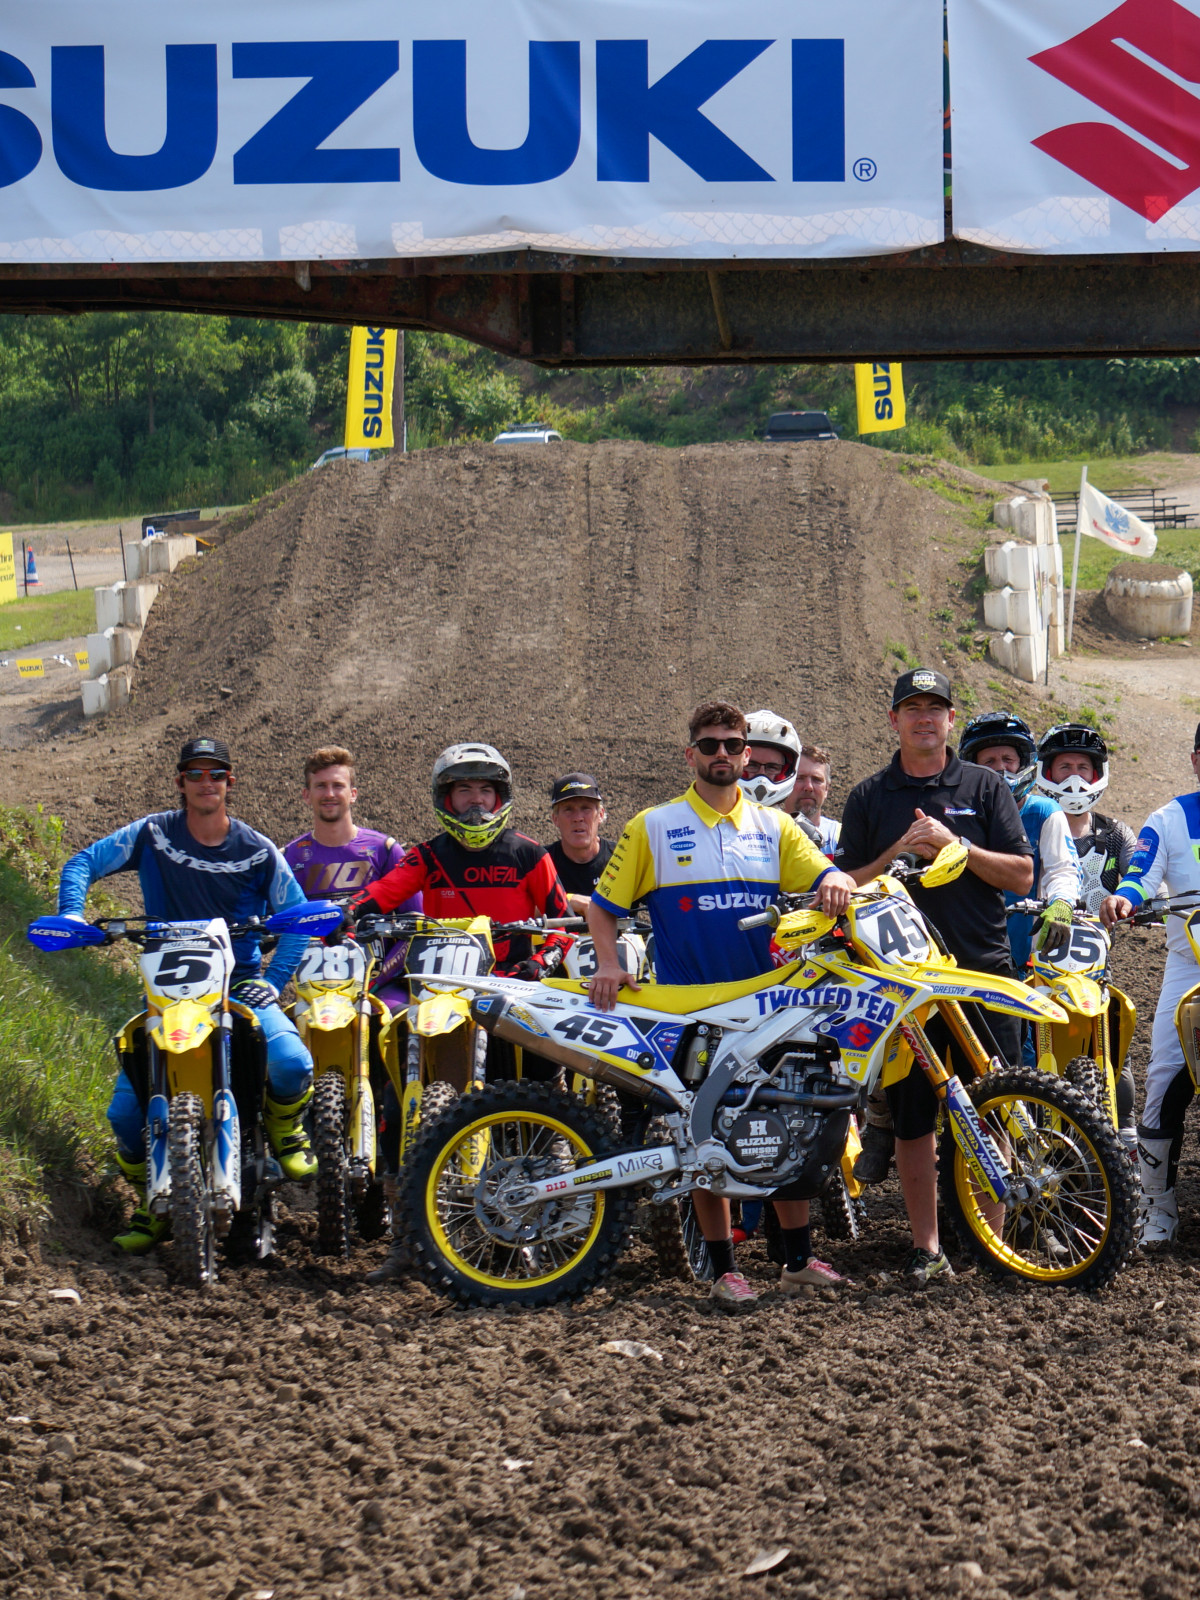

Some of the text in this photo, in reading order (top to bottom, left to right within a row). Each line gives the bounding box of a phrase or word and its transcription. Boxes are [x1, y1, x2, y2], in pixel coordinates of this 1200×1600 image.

[0, 38, 845, 191] UZUKI
[698, 892, 772, 911] SUZUKI
[298, 911, 341, 924] ACERBIS
[1053, 916, 1071, 925] 100%
[30, 928, 71, 938] ACERBIS
[877, 905, 928, 958] 45
[154, 950, 213, 986] 5
[418, 945, 481, 976] 110
[489, 983, 536, 993] DUNLOP
[755, 985, 898, 1027] TWISTED TEA
[554, 1014, 618, 1047] 45
[953, 1109, 979, 1151] ACERBIS
[963, 1104, 1010, 1173] DUNLOP
[736, 1136, 783, 1147] SUZUKI
[741, 1147, 778, 1155] HINSON
[618, 1153, 664, 1178] Mika
[546, 1181, 567, 1192] DID
[574, 1170, 613, 1184] HINSON
